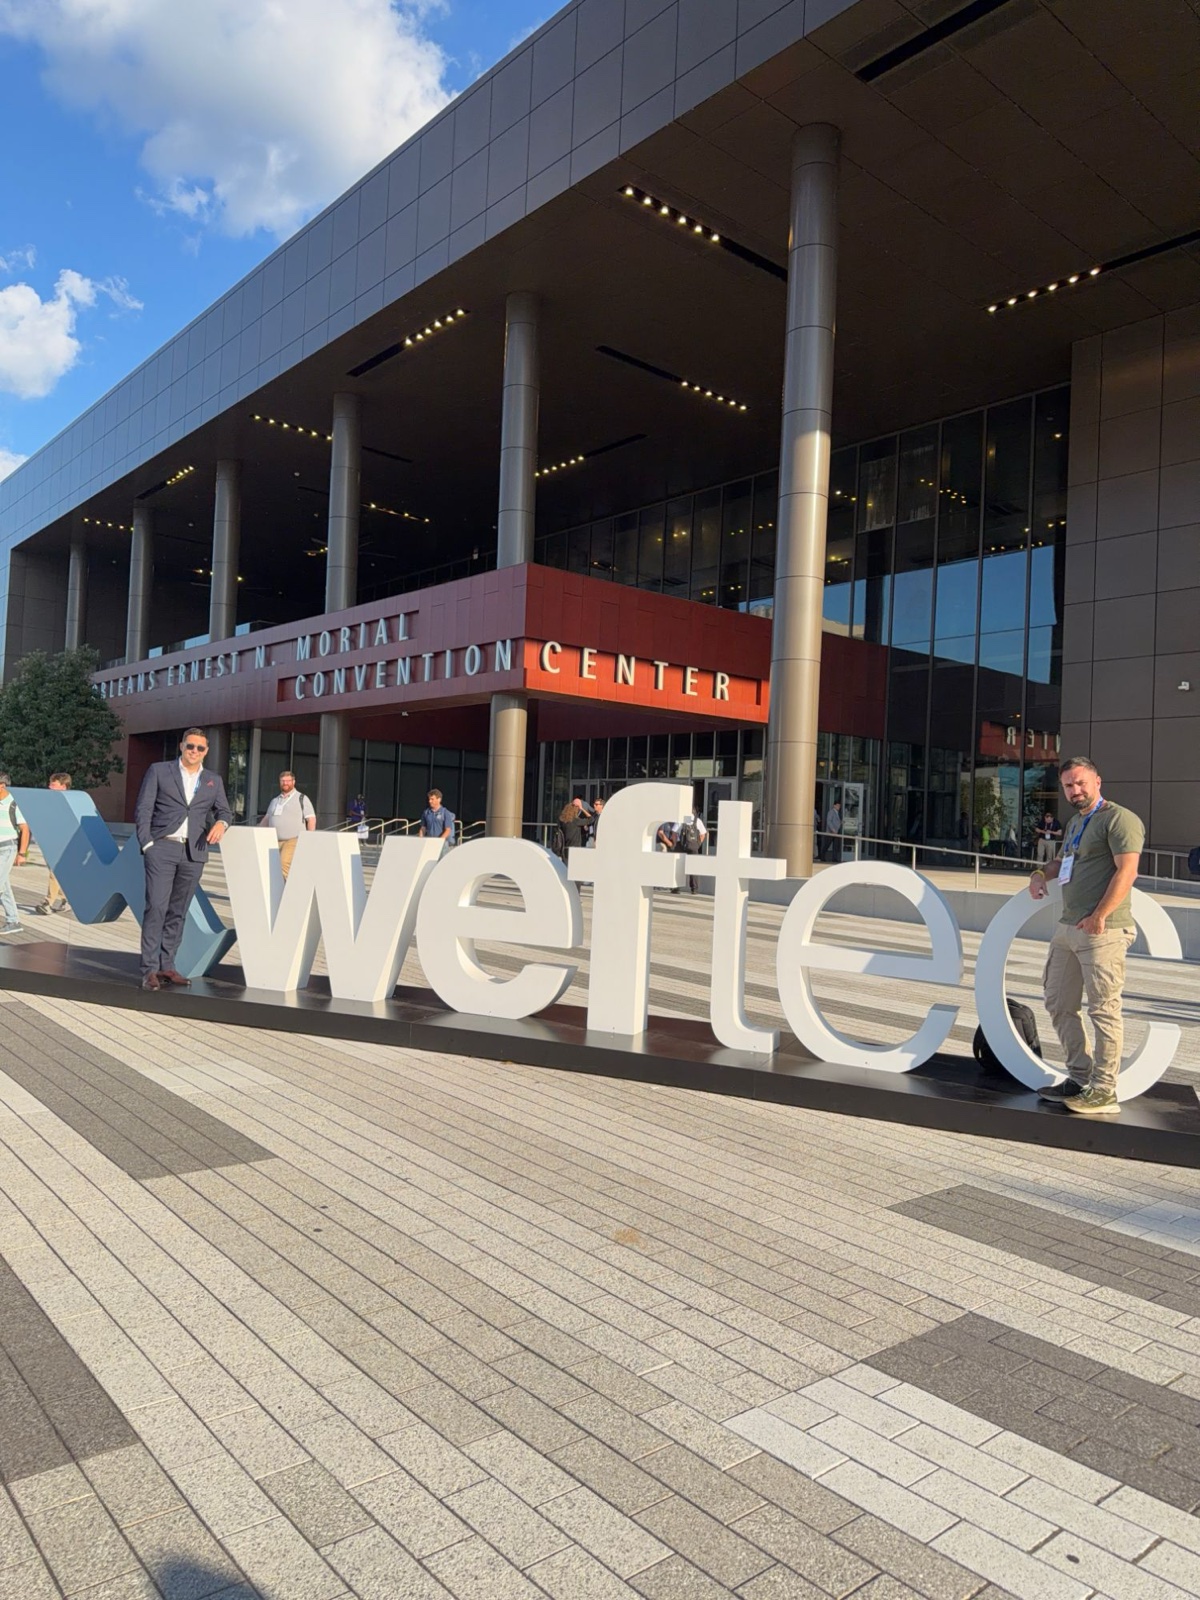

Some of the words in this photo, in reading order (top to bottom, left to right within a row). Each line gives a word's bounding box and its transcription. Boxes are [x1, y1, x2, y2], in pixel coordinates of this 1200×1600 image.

[167, 651, 239, 687] ERNEST
[255, 645, 276, 670] N.
[296, 613, 409, 662] MORIAL
[294, 639, 512, 700] CONVENTION
[540, 641, 730, 701] CENTER
[218, 782, 1183, 1101] weftec
